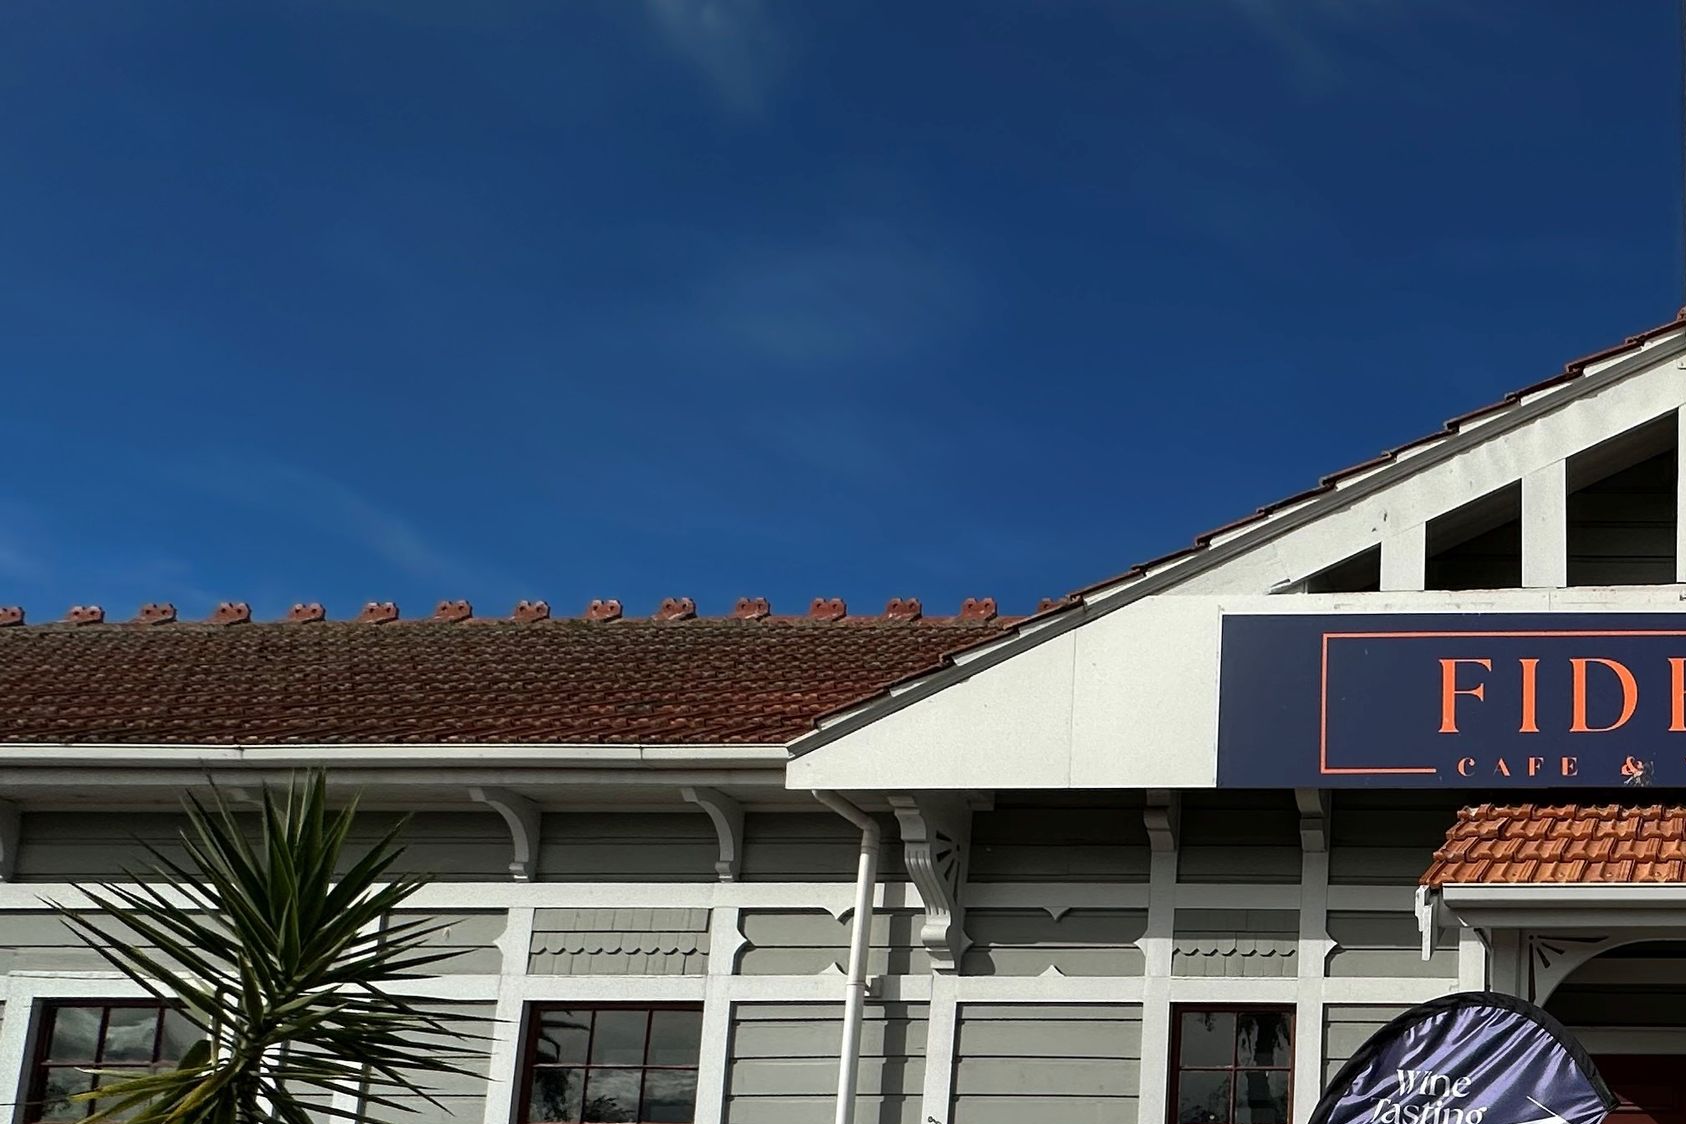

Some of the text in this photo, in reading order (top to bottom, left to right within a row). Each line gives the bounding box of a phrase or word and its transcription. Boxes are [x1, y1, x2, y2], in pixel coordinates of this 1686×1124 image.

[1457, 757, 1579, 777] CAFE
[1621, 757, 1646, 777] &
[1397, 1069, 1472, 1098] Wine
